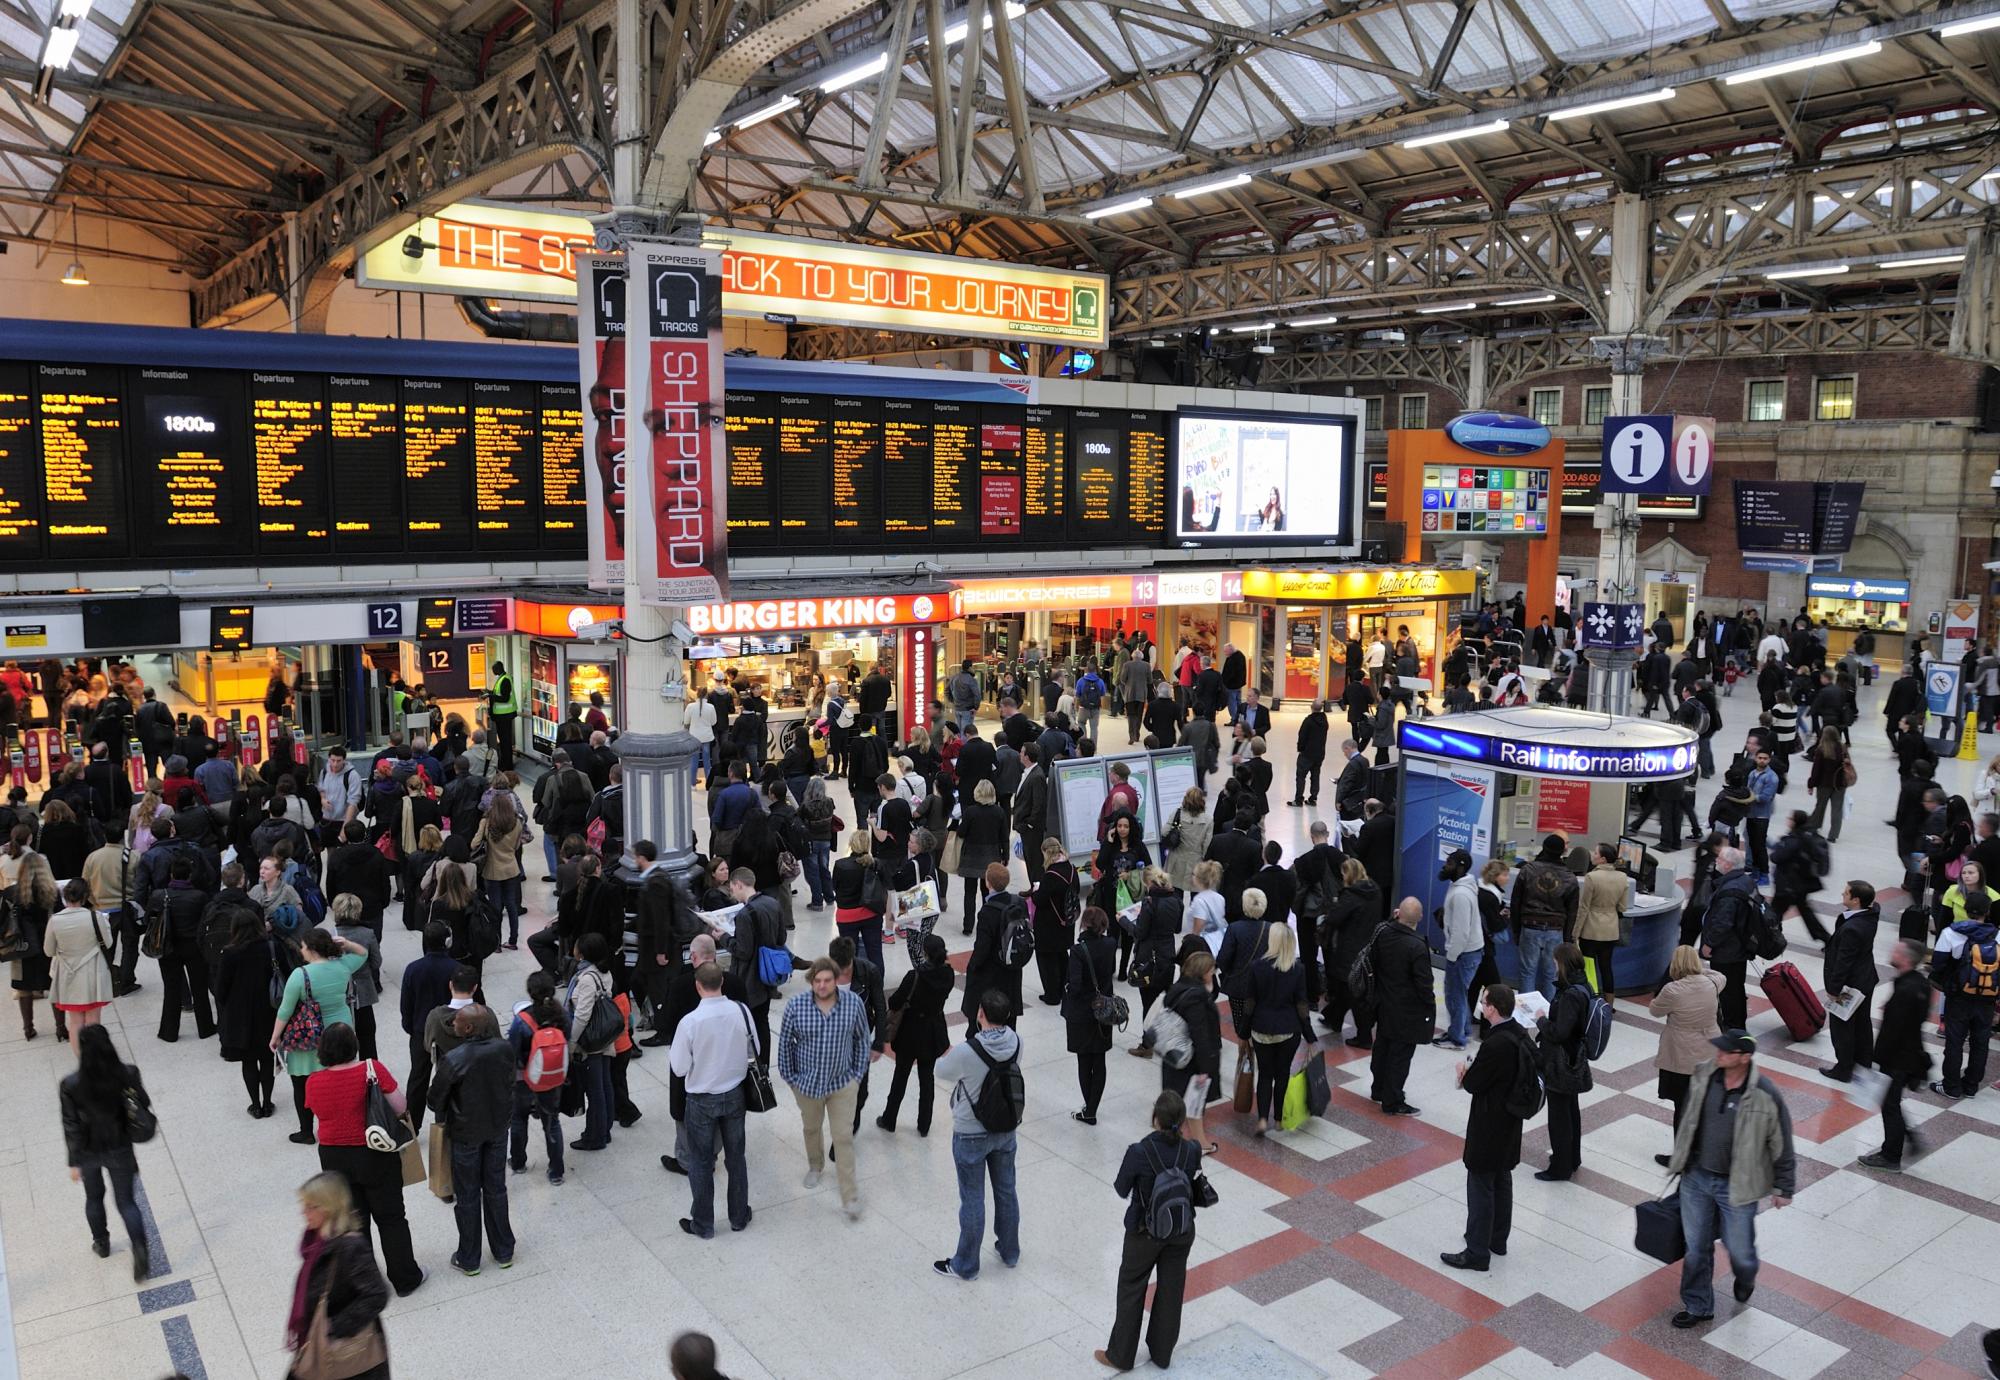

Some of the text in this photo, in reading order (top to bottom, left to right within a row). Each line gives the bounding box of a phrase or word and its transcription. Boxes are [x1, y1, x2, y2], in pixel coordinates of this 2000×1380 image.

[443, 224, 522, 269] THE
[795, 262, 835, 298] TO
[848, 269, 931, 308] YOUR
[941, 279, 1070, 322] JOURNEY
[660, 321, 698, 333] TRACKS
[40, 366, 87, 376] Departures
[142, 370, 188, 379] Information
[253, 373, 295, 383] Departures
[330, 376, 370, 386] Departures
[404, 380, 442, 389] Departures
[474, 382, 511, 392] Departures
[542, 386, 576, 394] Departures
[725, 394, 755, 403] Departures
[781, 396, 809, 405] Departures
[834, 399, 862, 407] Departures
[358, 403, 388, 412] Platform
[428, 406, 456, 414] Platform
[885, 401, 912, 410] Departures
[934, 403, 960, 411] Departures
[475, 415, 498, 423] Sutton
[663, 351, 704, 569] SHEPPARD
[1578, 474, 1588, 482] AS
[260, 523, 295, 531] Southern
[336, 522, 370, 531] Southern
[409, 522, 441, 530] Southern
[674, 579, 716, 588] SOUNDTRACK
[1225, 579, 1241, 596] 14
[1307, 581, 1331, 591] Crust
[1377, 574, 1440, 595] Upper Crust
[1136, 581, 1154, 600] 13
[1162, 583, 1200, 595] Tickets
[373, 608, 398, 629] 12
[691, 597, 896, 632] BURGER KING
[428, 651, 449, 668] 12
[914, 643, 925, 724] BURGER KING
[1501, 742, 1541, 768] Rail
[1547, 747, 1667, 774] information
[1438, 806, 1460, 815] Welcome
[1438, 815, 1471, 830] Victoria
[1437, 828, 1469, 842] Station
